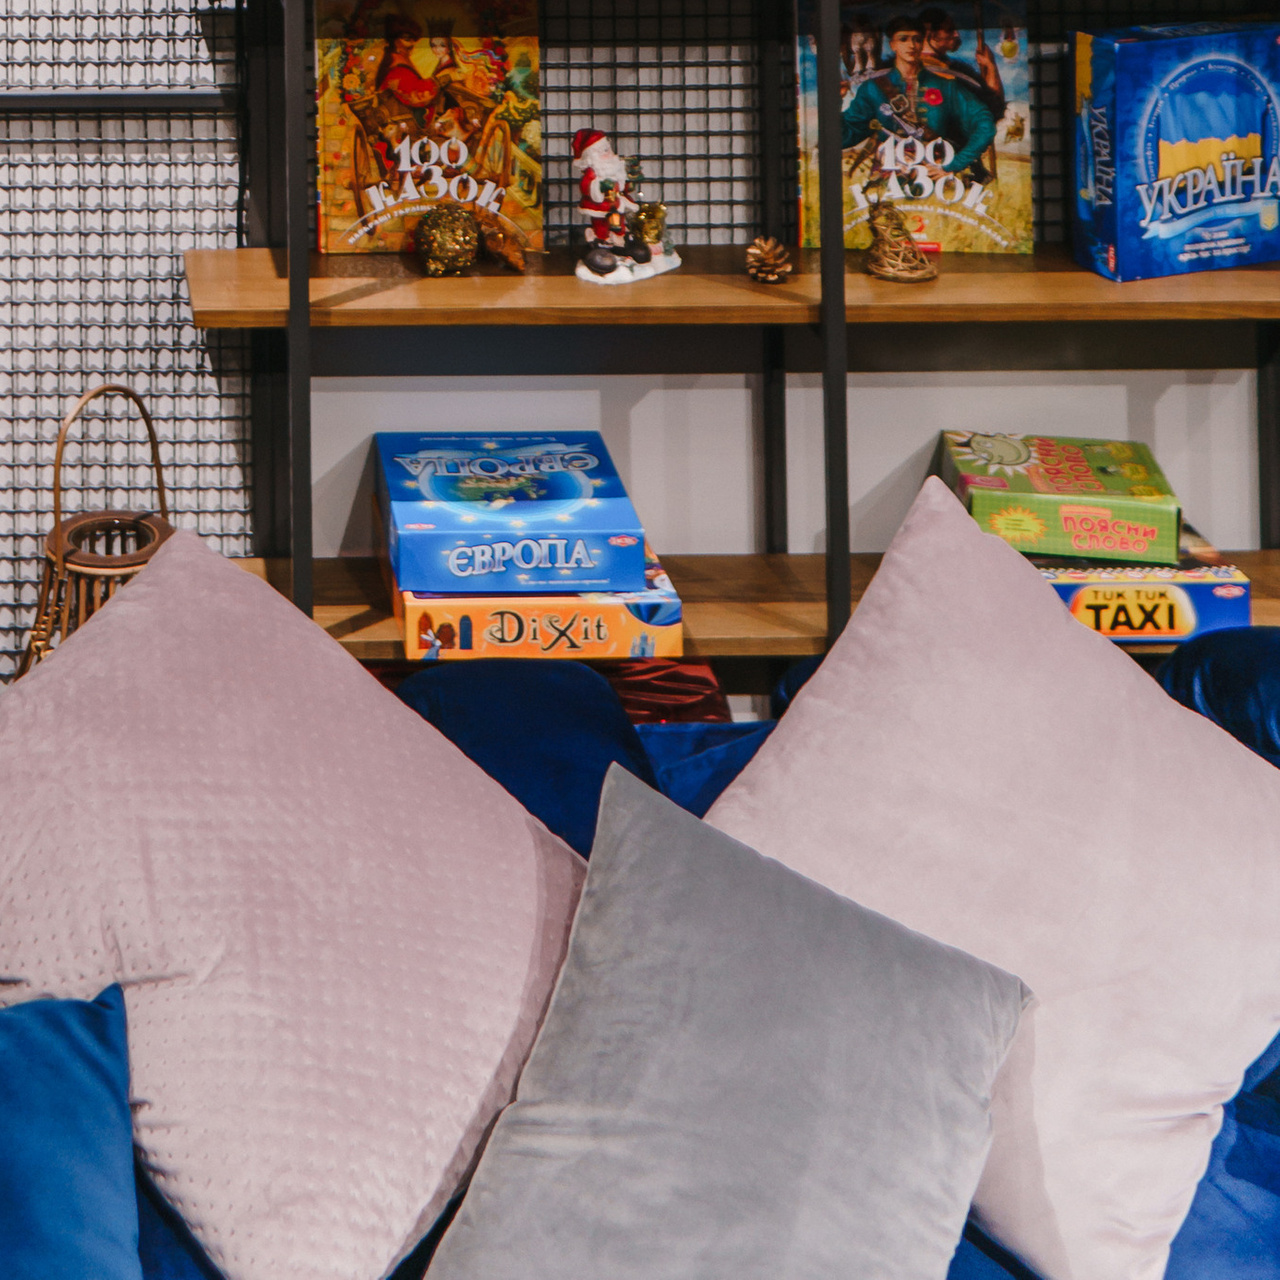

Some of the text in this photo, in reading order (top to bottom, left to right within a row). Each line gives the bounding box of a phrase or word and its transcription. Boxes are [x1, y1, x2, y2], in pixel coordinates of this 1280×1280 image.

[394, 135, 468, 172] 100
[877, 135, 955, 170] 100
[1090, 106, 1116, 205] УКРАЇНА
[364, 165, 508, 216] КАЗОК
[849, 164, 994, 215] КАЗОК
[1135, 152, 1280, 228] УКРАЇНА
[393, 452, 600, 480] ЄВРОПА
[1061, 516, 1158, 541] ПОЯСНИ
[1072, 533, 1149, 554] СЛОВО
[447, 538, 597, 577] ЄВРОПА
[1093, 590, 1169, 601] TUK TUK
[1085, 603, 1175, 631] TAXI
